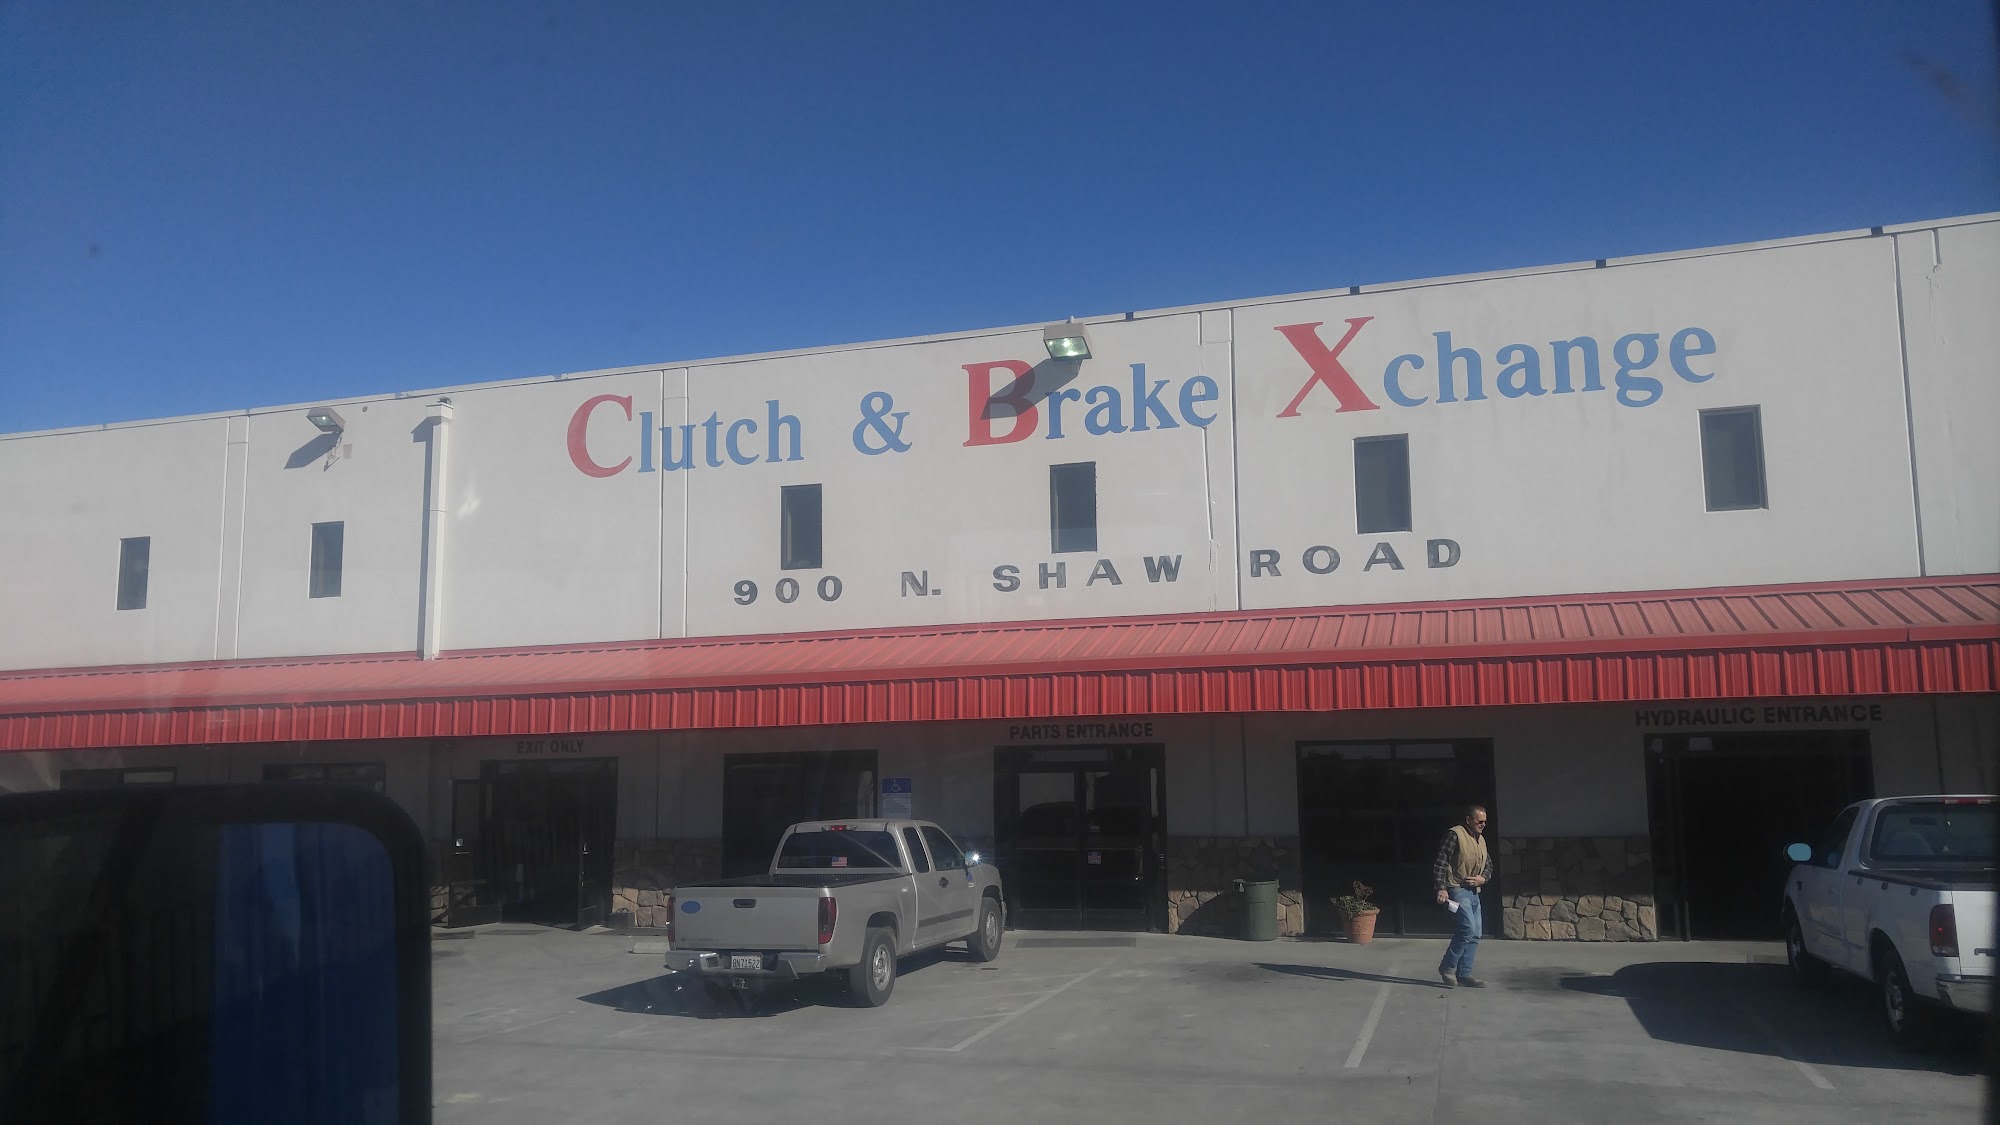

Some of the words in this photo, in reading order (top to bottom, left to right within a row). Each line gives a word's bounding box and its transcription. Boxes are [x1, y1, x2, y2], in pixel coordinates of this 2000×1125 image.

[566, 393, 804, 478] Clutch
[852, 391, 912, 456] &
[961, 359, 1219, 448] Brake
[1273, 315, 1717, 419] Xchange
[733, 575, 843, 606] 900
[901, 570, 942, 597] N.
[992, 554, 1182, 592] SHAW
[1249, 538, 1462, 578] ROAD
[1635, 706, 1755, 727] HYDRAULIC
[1763, 704, 1883, 723] ENTRANCE
[1009, 724, 1060, 739] PARTS
[1066, 722, 1153, 739] ENTRANCE
[517, 741, 544, 754] EXIT
[550, 740, 584, 753] ONLY
